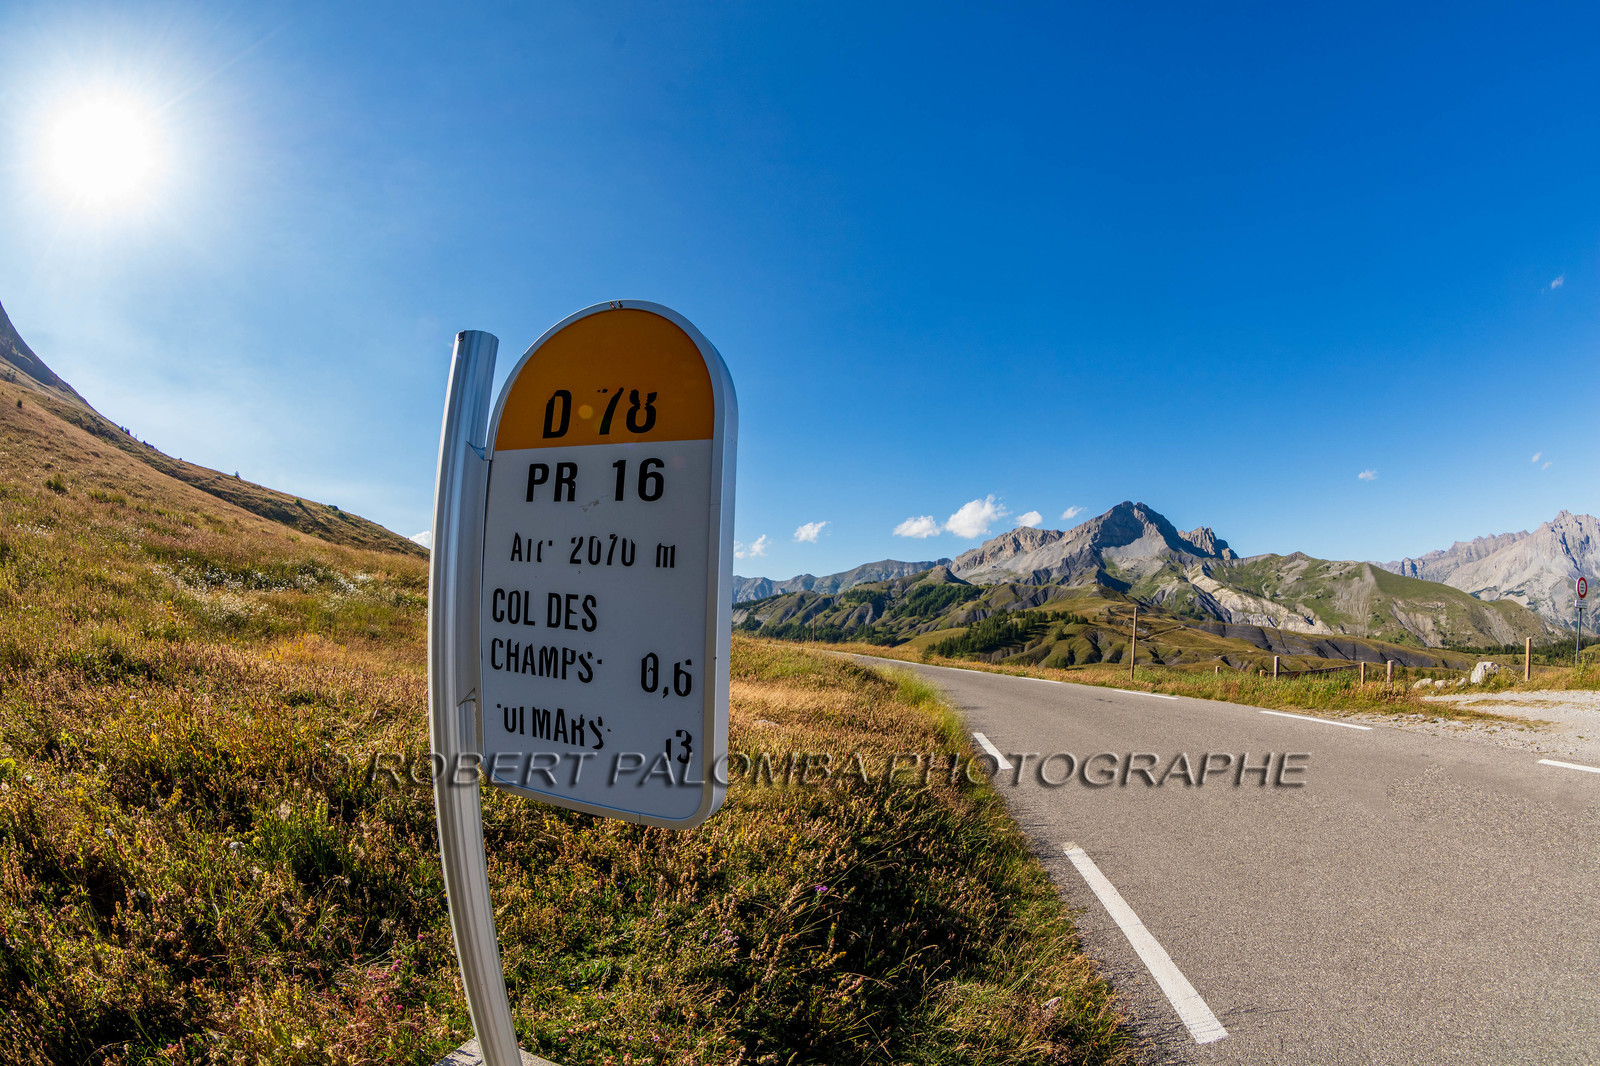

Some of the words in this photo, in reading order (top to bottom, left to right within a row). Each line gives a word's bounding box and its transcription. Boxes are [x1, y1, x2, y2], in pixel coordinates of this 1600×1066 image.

[542, 389, 573, 439] D
[525, 461, 579, 503] PR
[612, 457, 665, 502] 16
[569, 533, 636, 567] 2070
[655, 542, 676, 569] m
[492, 587, 536, 627] COL
[546, 592, 598, 633] DES
[490, 637, 595, 684] CHAMPS
[640, 651, 693, 699] 0,6
[496, 703, 605, 750] OLMARS
[664, 729, 693, 765] 13
